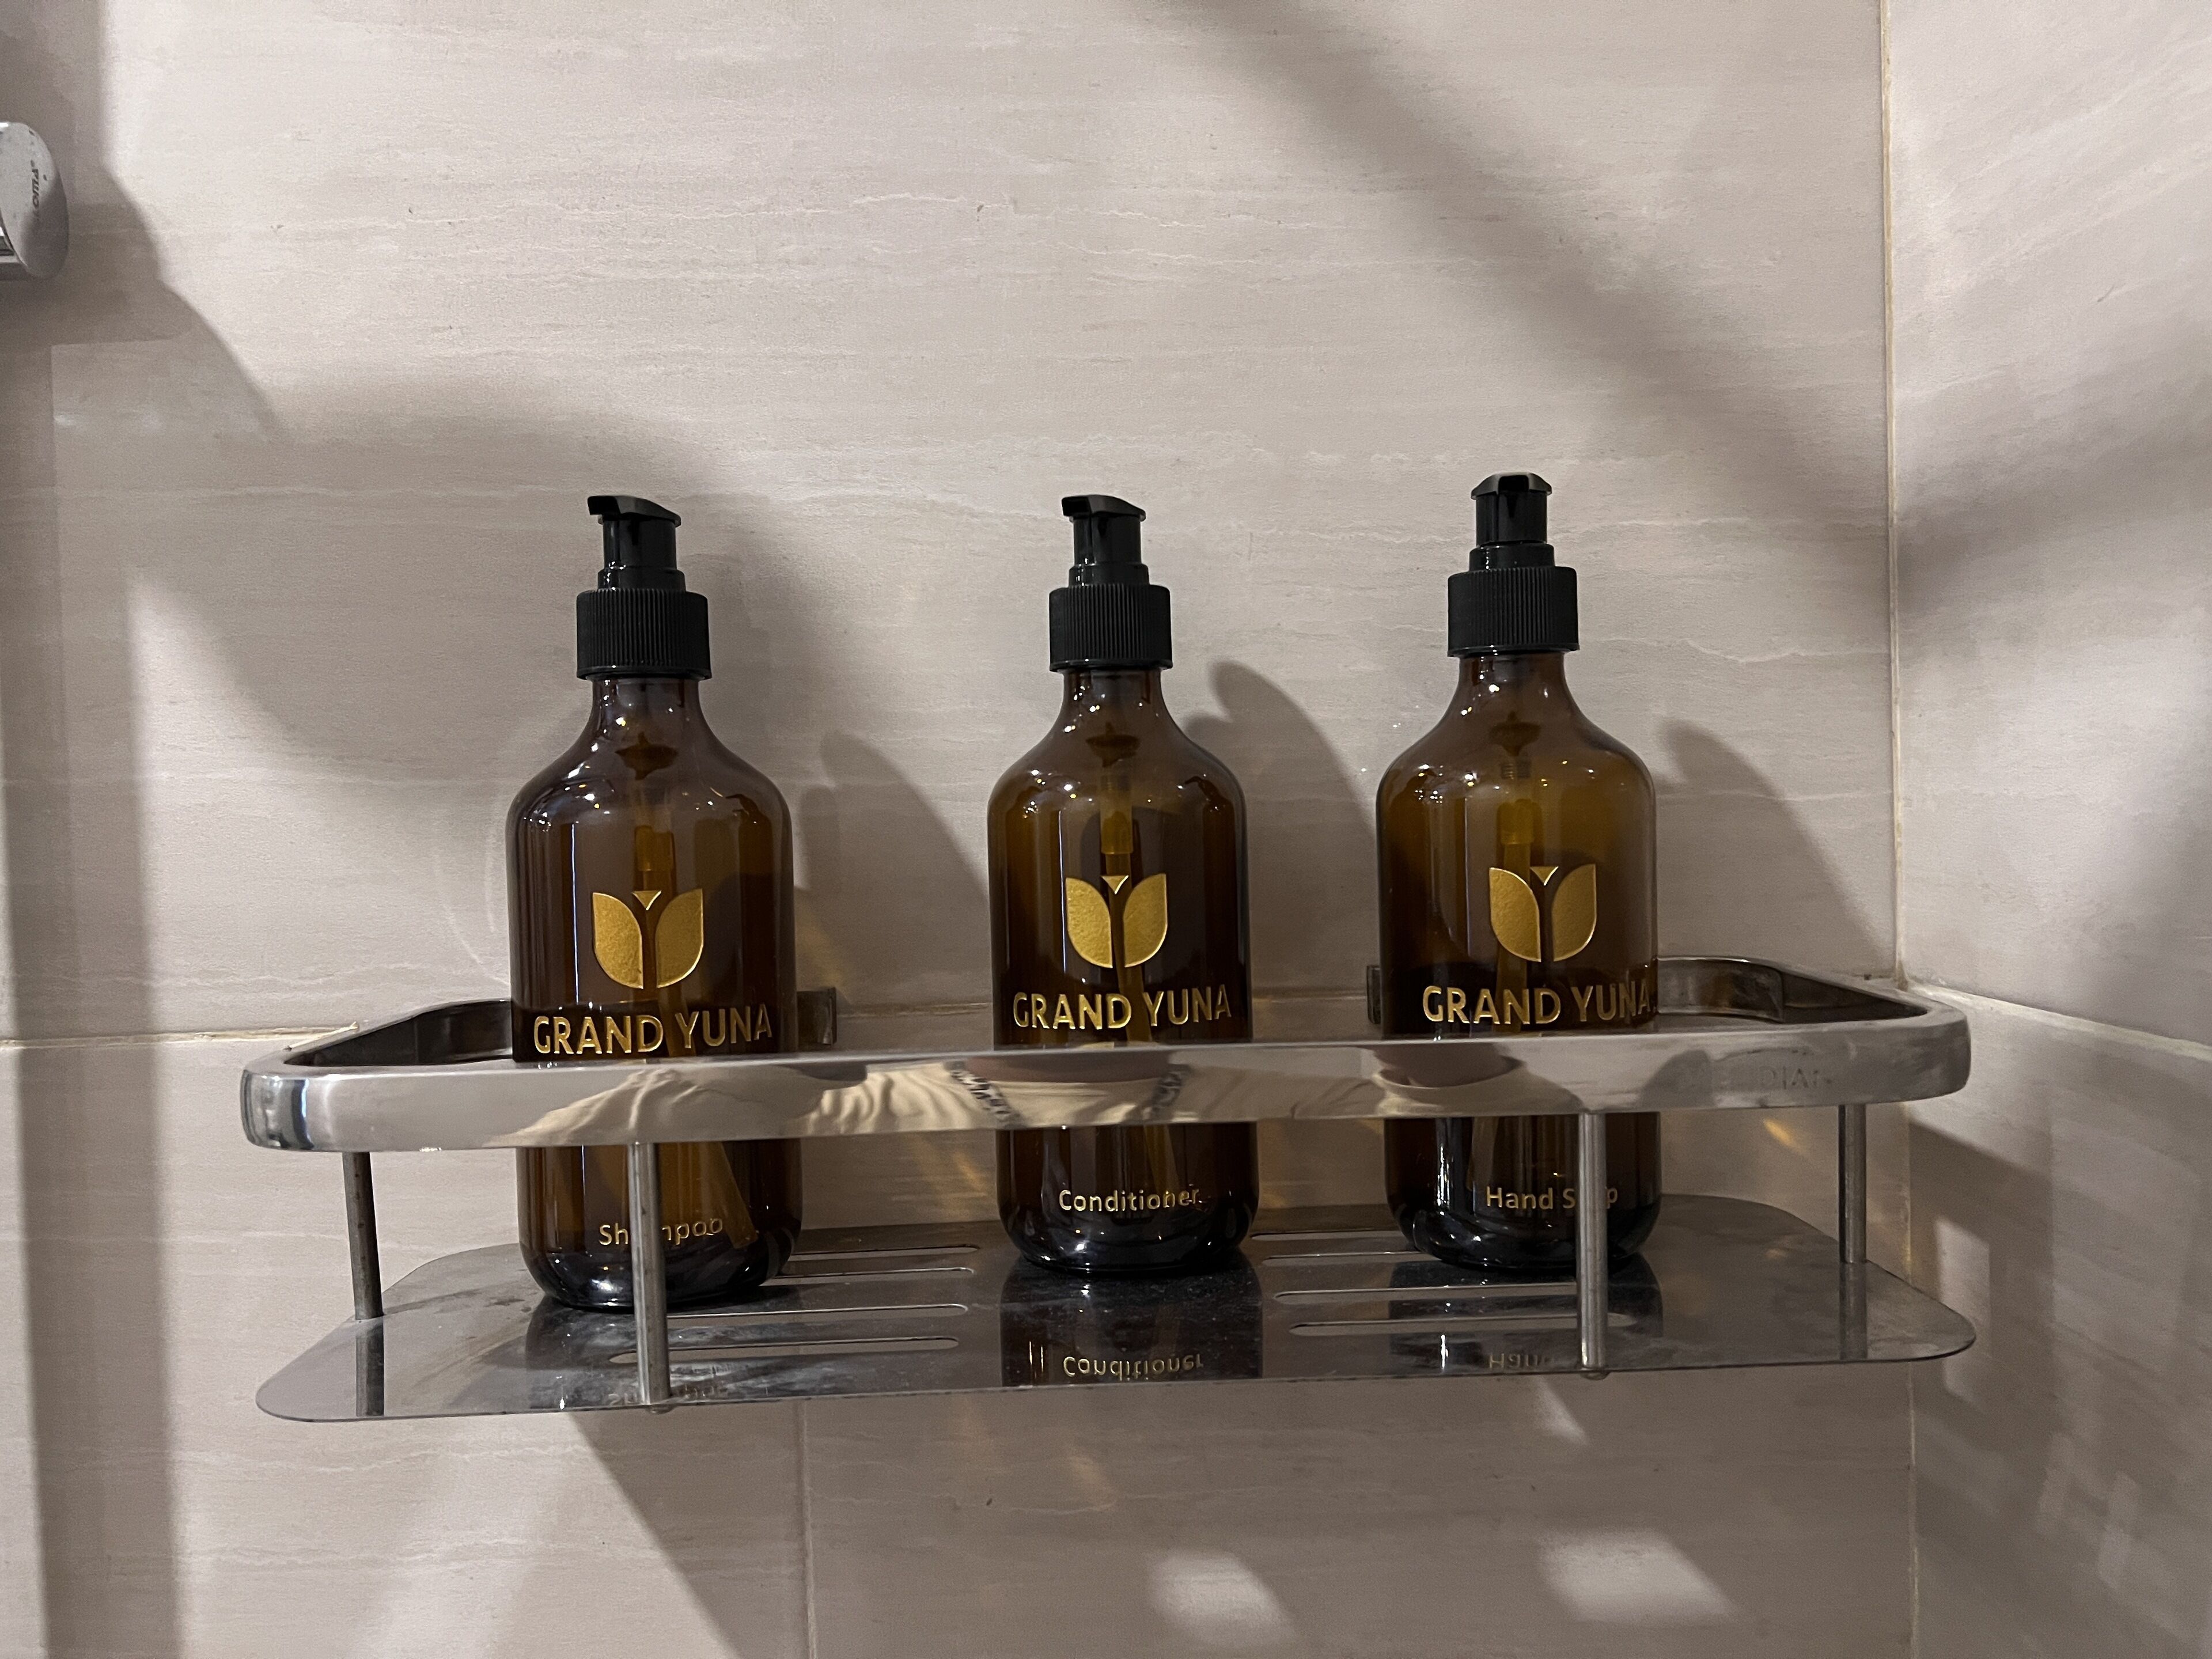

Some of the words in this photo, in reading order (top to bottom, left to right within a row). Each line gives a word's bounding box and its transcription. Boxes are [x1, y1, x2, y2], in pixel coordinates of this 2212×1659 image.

[1013, 991, 1132, 1029] GRAND
[1142, 984, 1232, 1027] YUNA
[1422, 984, 1561, 1024] GRAND
[1570, 979, 1651, 1022] YUNA
[533, 1014, 664, 1054] GRAND
[675, 1003, 773, 1049] YUNA
[1059, 1187, 1200, 1211] Conditioner
[1486, 1185, 1554, 1210] Hand
[1562, 1187, 1618, 1209] Sp
[598, 1218, 723, 1246] Shpoo
